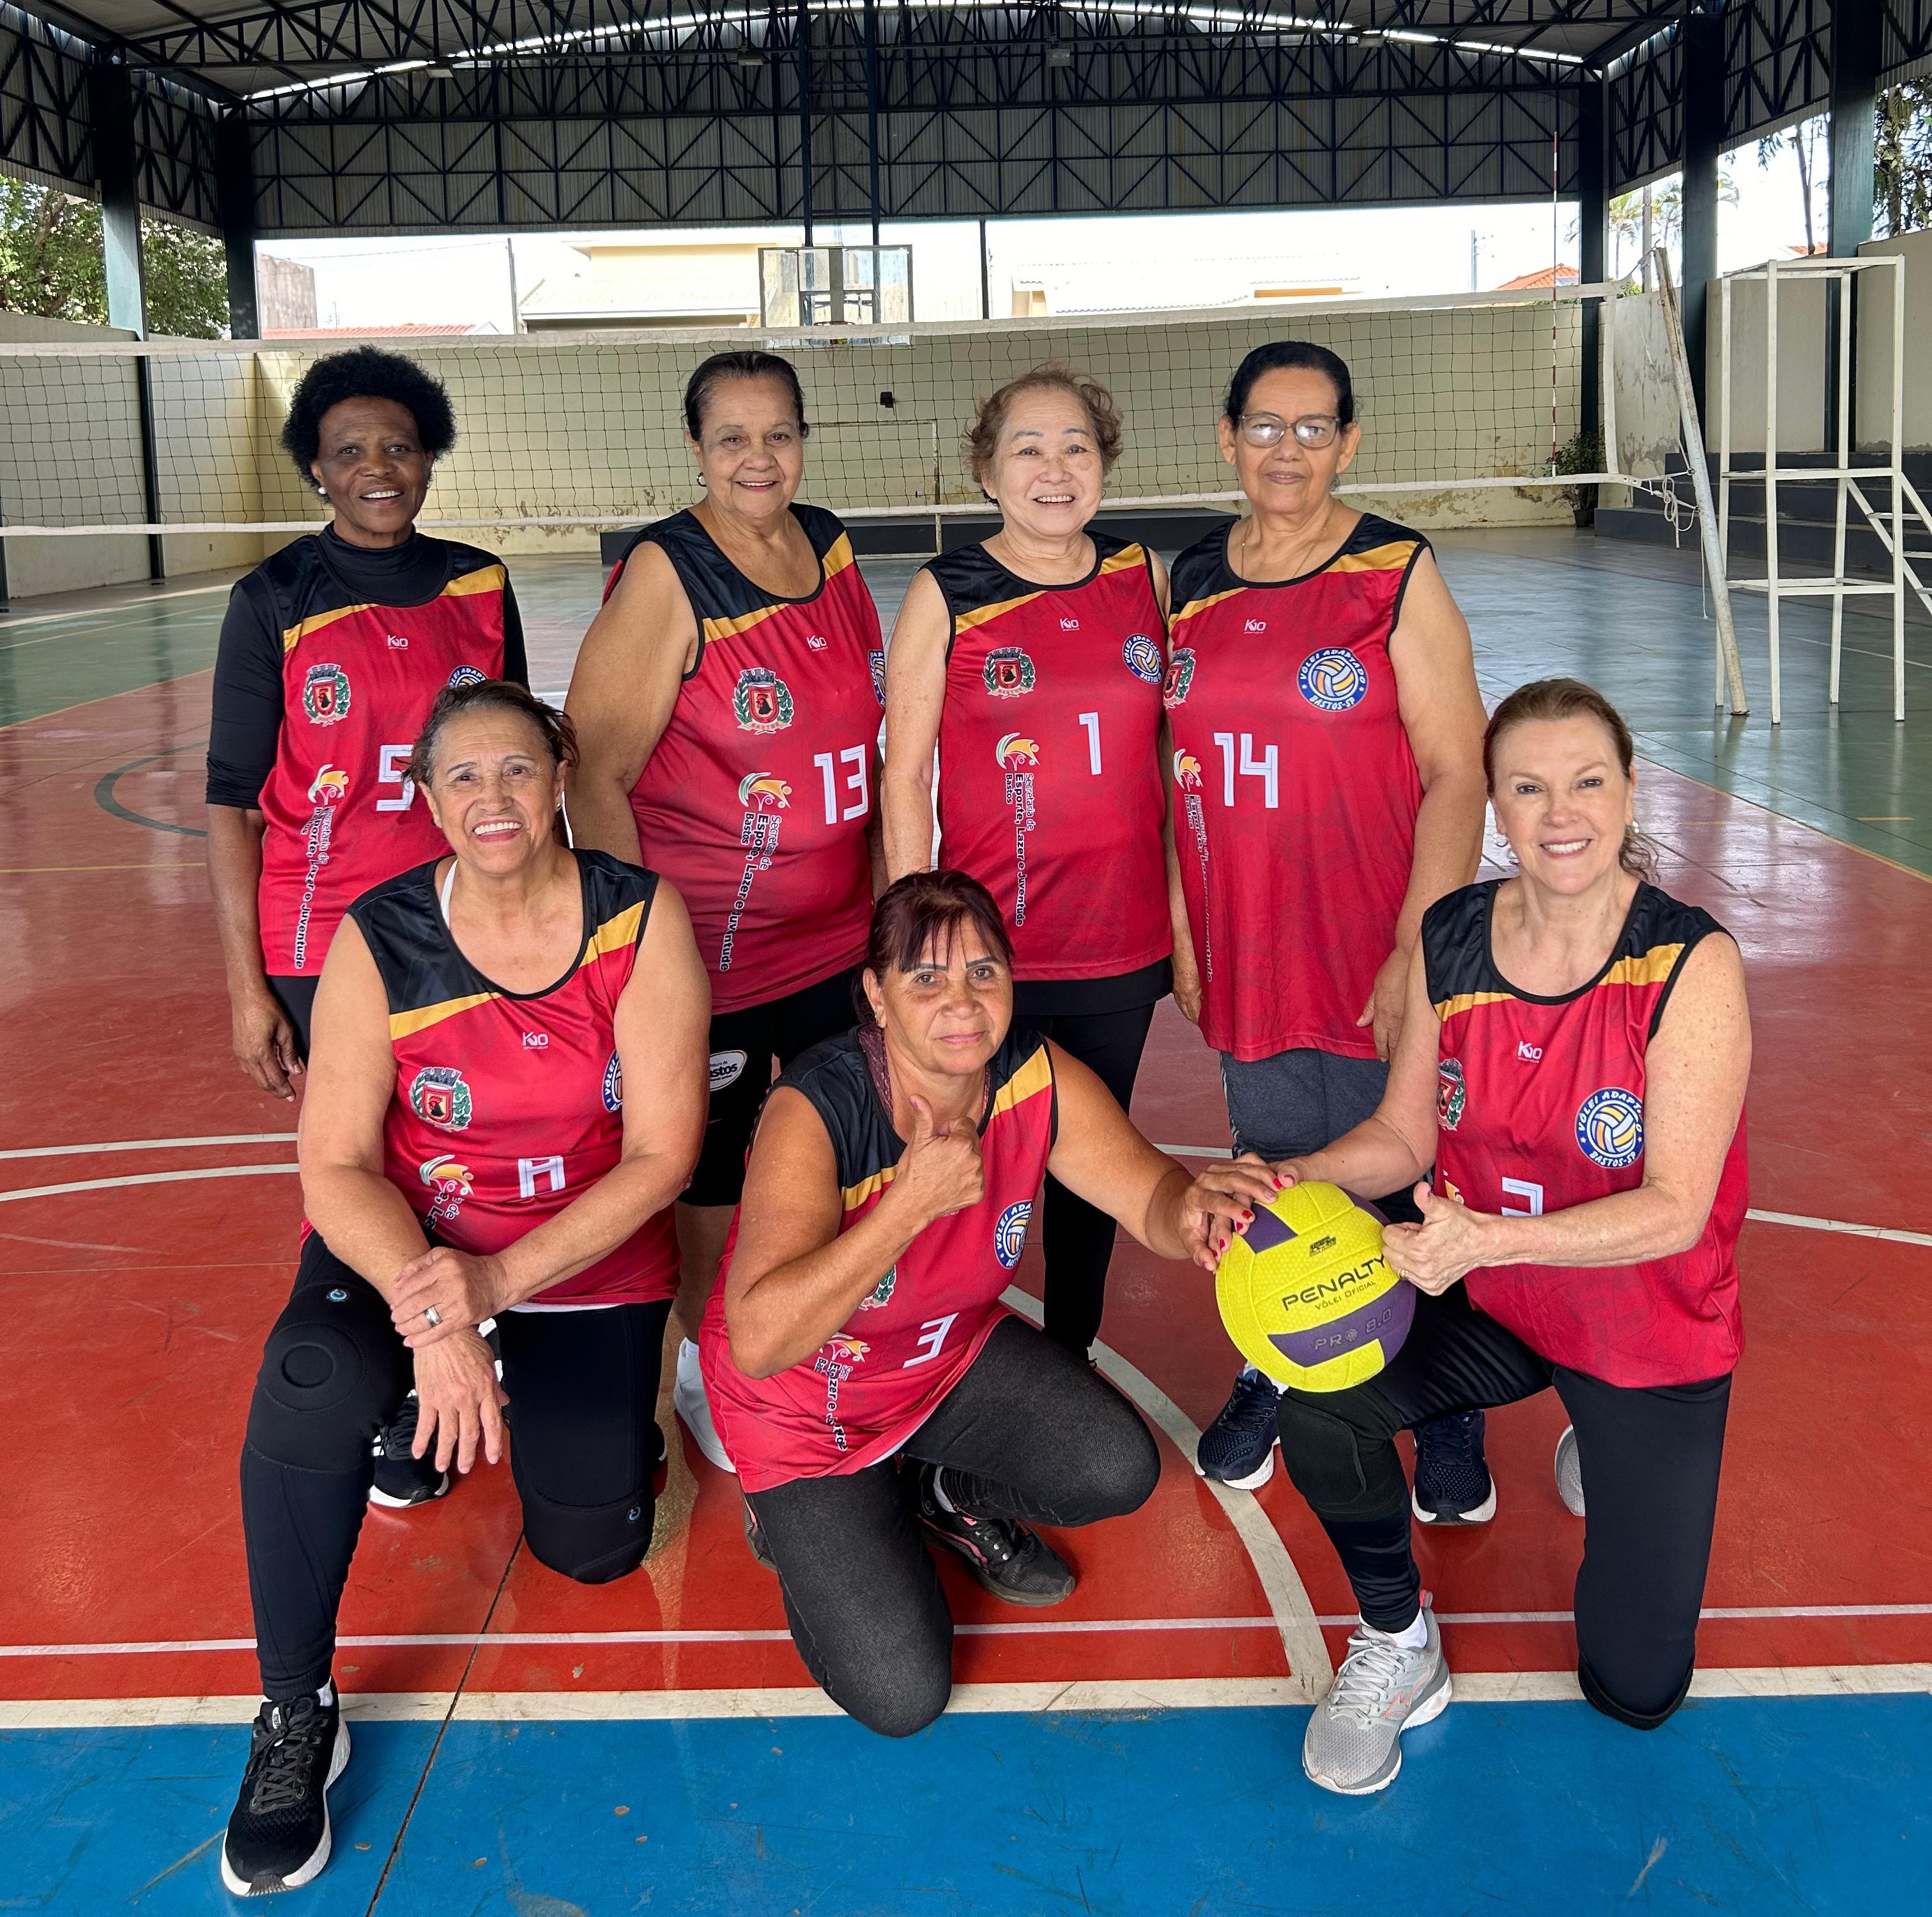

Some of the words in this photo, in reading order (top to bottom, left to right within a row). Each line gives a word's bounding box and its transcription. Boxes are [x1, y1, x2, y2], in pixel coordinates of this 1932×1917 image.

[461, 668, 486, 681] ADAPT
[1300, 653, 1320, 680] VOLEI
[1323, 649, 1366, 684] ADAPTADO
[1309, 695, 1355, 710] BASTOS-SP
[1078, 712, 1102, 775] 1
[376, 744, 415, 811] 5
[813, 744, 869, 825] 13
[1213, 732, 1278, 808] 14
[1014, 773, 1024, 824] Esporte,
[1025, 773, 1035, 817] Secretaria
[742, 813, 755, 844] Bastos
[747, 814, 769, 860] Espore,
[1026, 819, 1035, 830] de
[319, 852, 329, 864] de
[1016, 827, 1025, 860] Lazer
[760, 857, 771, 869] de
[738, 864, 758, 900] Lazer
[1016, 872, 1027, 926] Juventude
[735, 900, 744, 909] e
[710, 1063, 738, 1078] stos
[1578, 1096, 1598, 1131] VOLEI
[1602, 1091, 1643, 1132] ADAPTO
[1590, 1151, 1636, 1166] BASTOS-SP
[996, 1214, 1009, 1249] VOLEI
[1282, 1253, 1385, 1311] PENALTY
[1344, 1280, 1376, 1298] OFICIAL
[902, 1312, 959, 1369] 3
